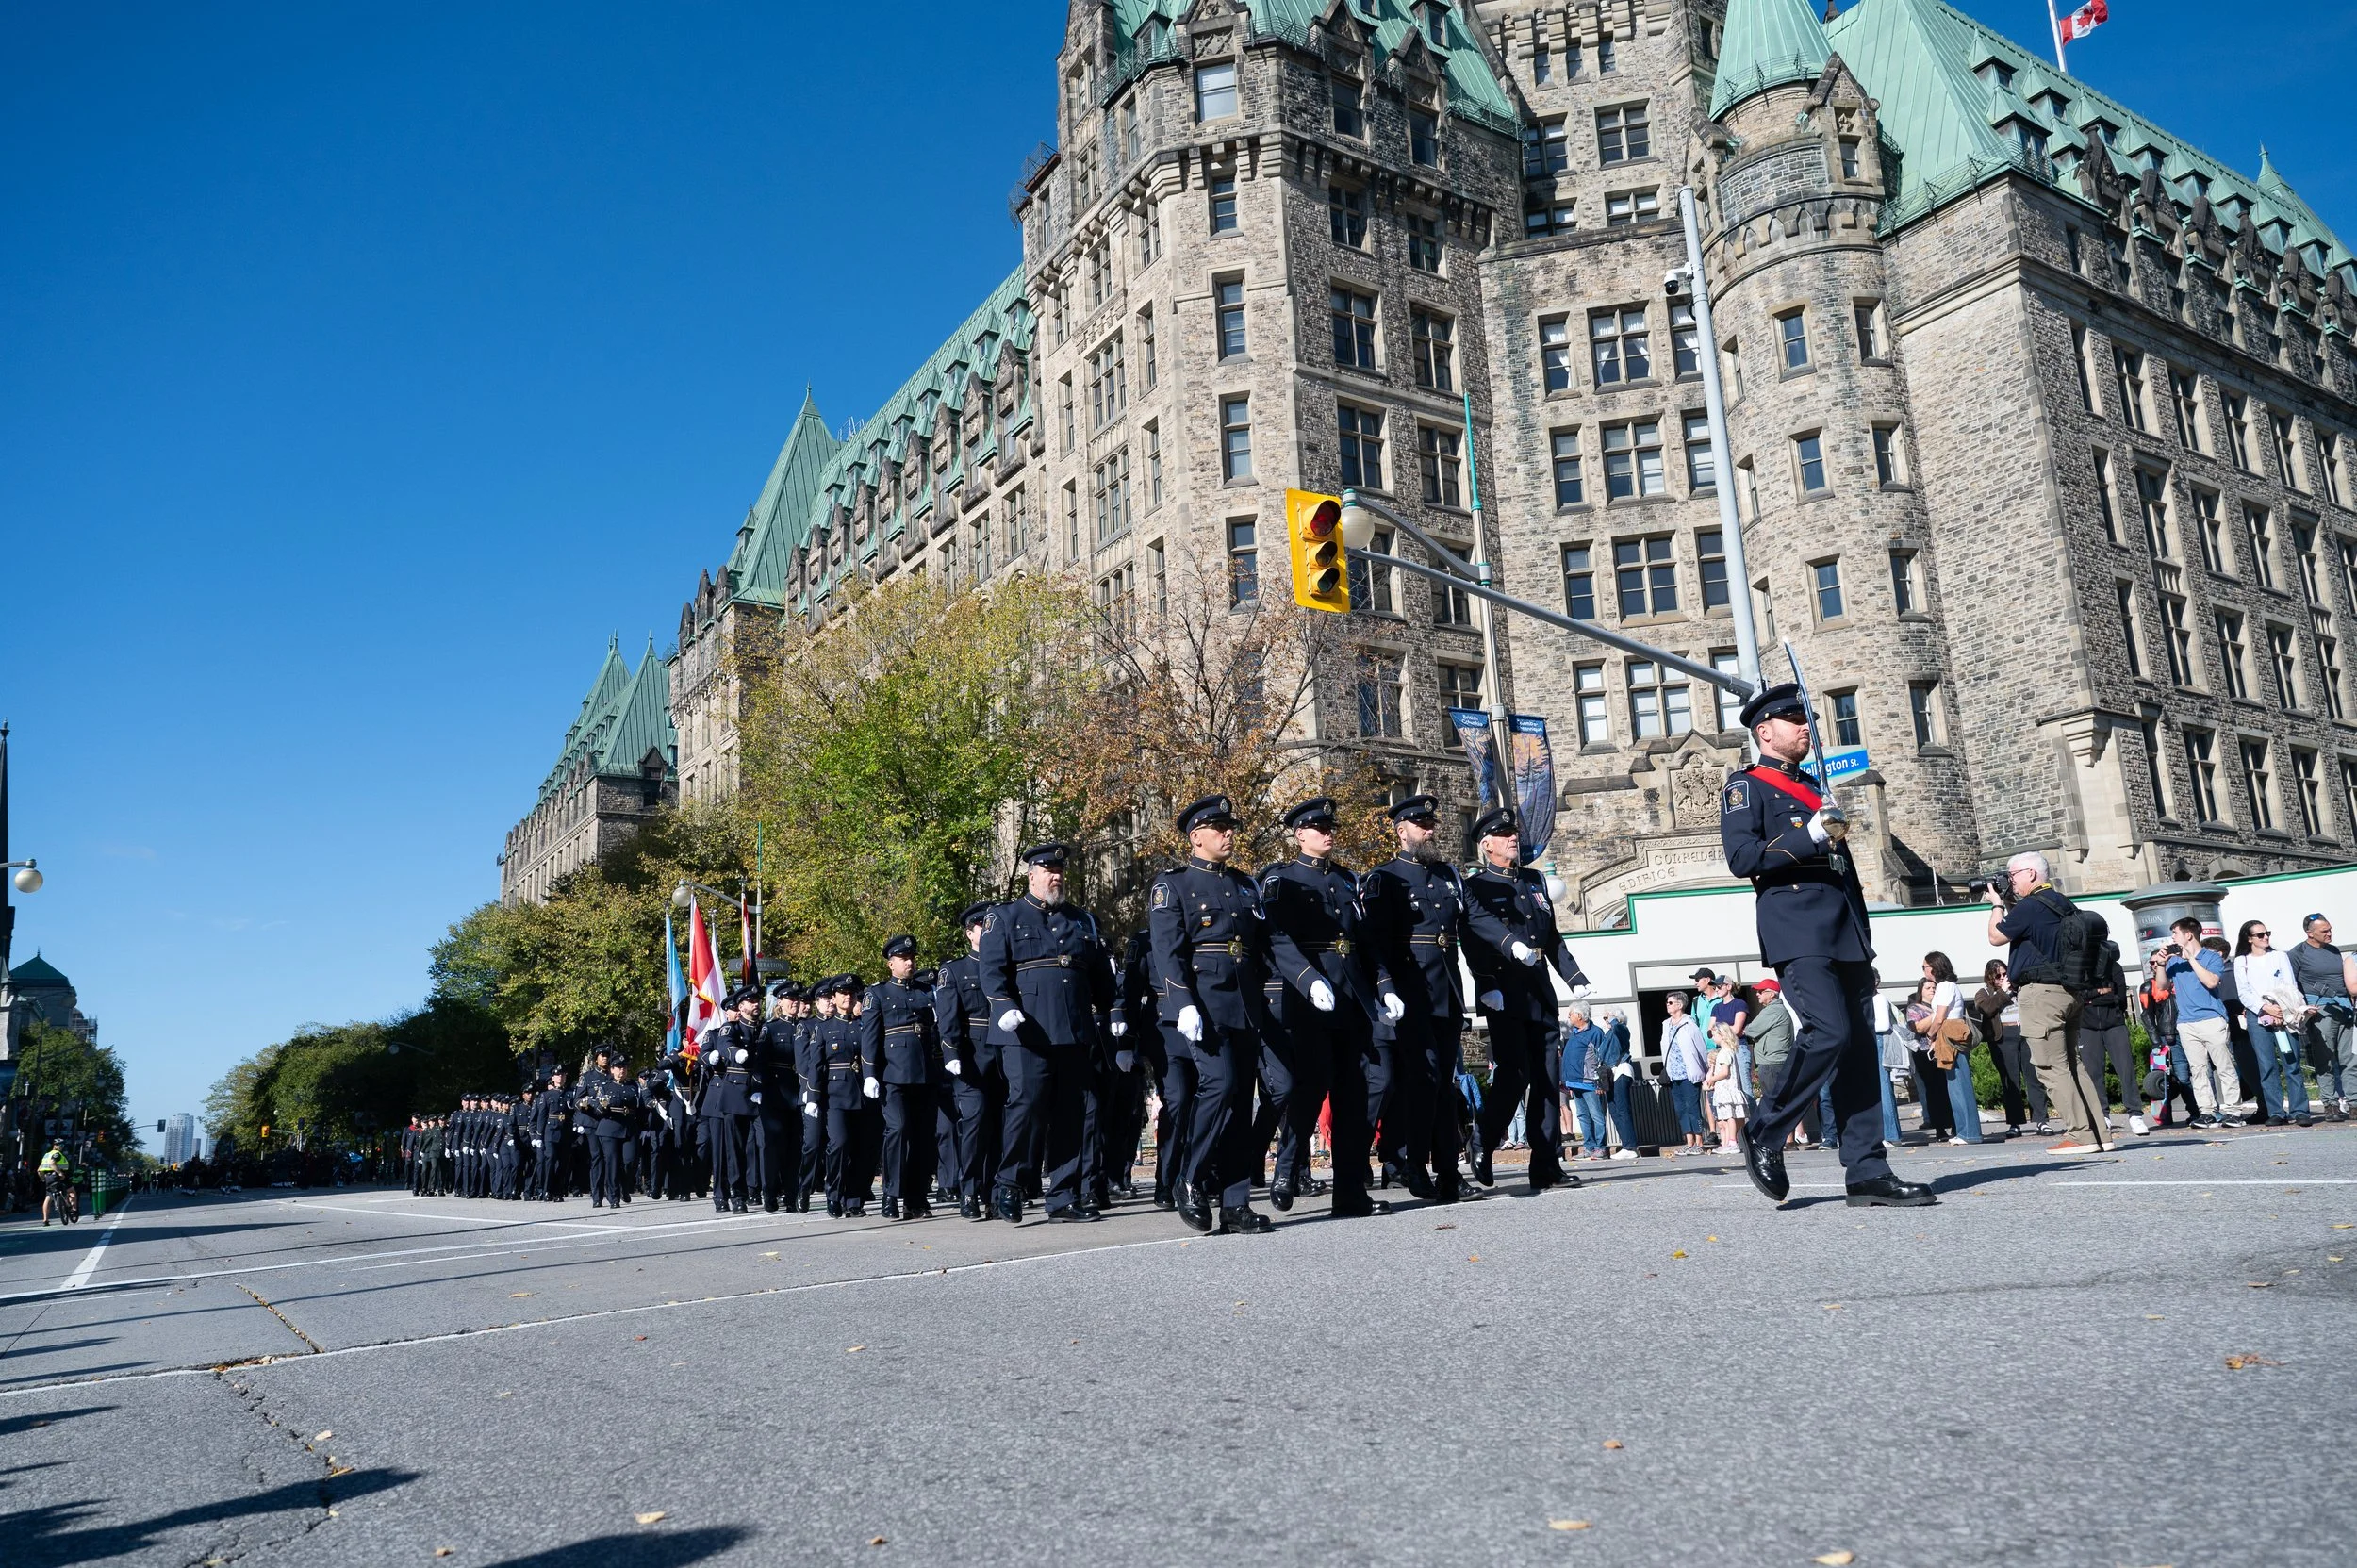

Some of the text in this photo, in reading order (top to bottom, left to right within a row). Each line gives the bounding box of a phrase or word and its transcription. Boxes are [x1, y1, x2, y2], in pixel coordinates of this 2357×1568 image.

[1799, 758, 1859, 776] ellgton St.
[1654, 850, 1726, 866] CONFEDER
[1618, 867, 1676, 892] EDIFICE
